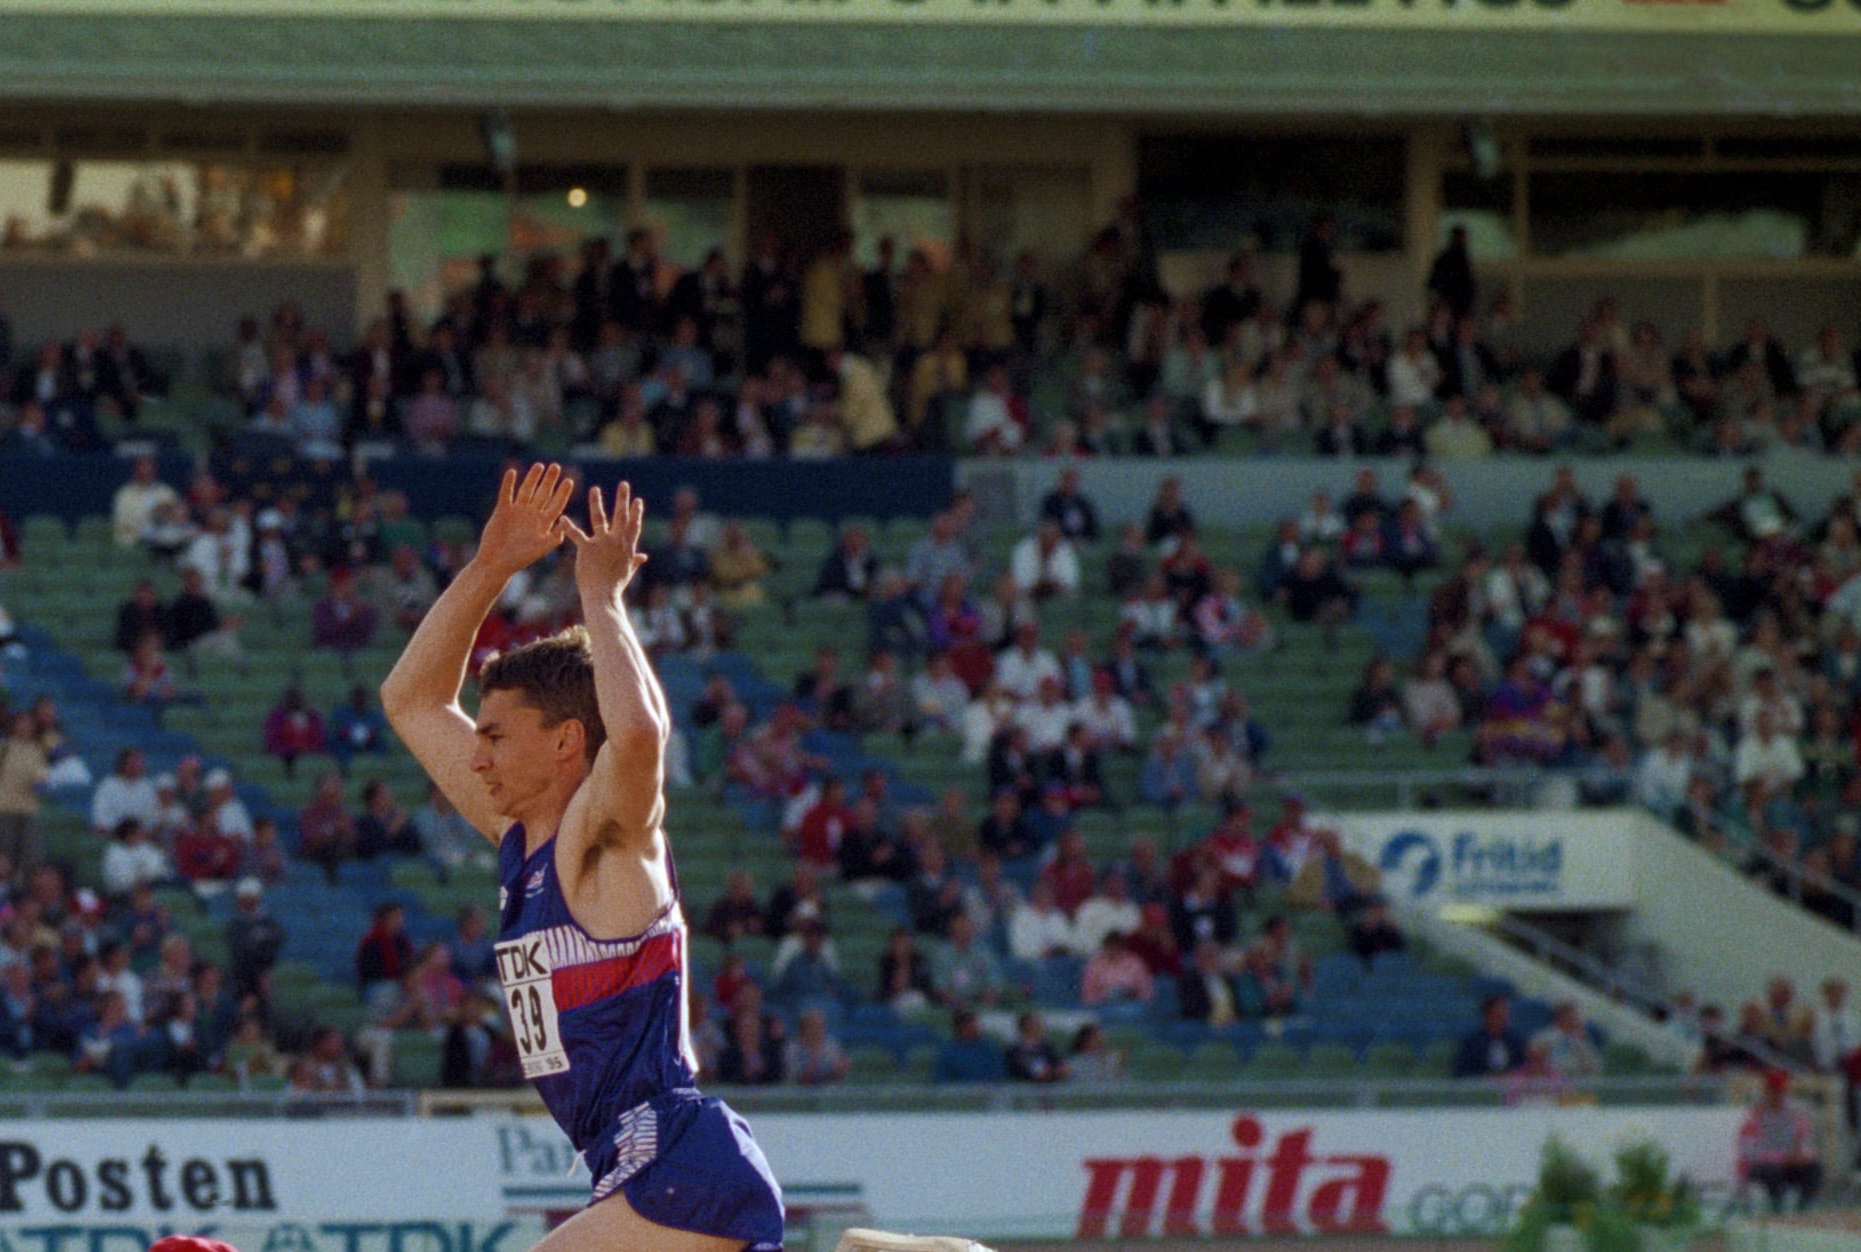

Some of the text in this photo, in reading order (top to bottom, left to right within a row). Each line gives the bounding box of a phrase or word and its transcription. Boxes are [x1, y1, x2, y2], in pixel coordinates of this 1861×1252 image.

[496, 941, 548, 982] TDK
[511, 985, 547, 1055] 39
[1075, 1113, 1391, 1237] mita
